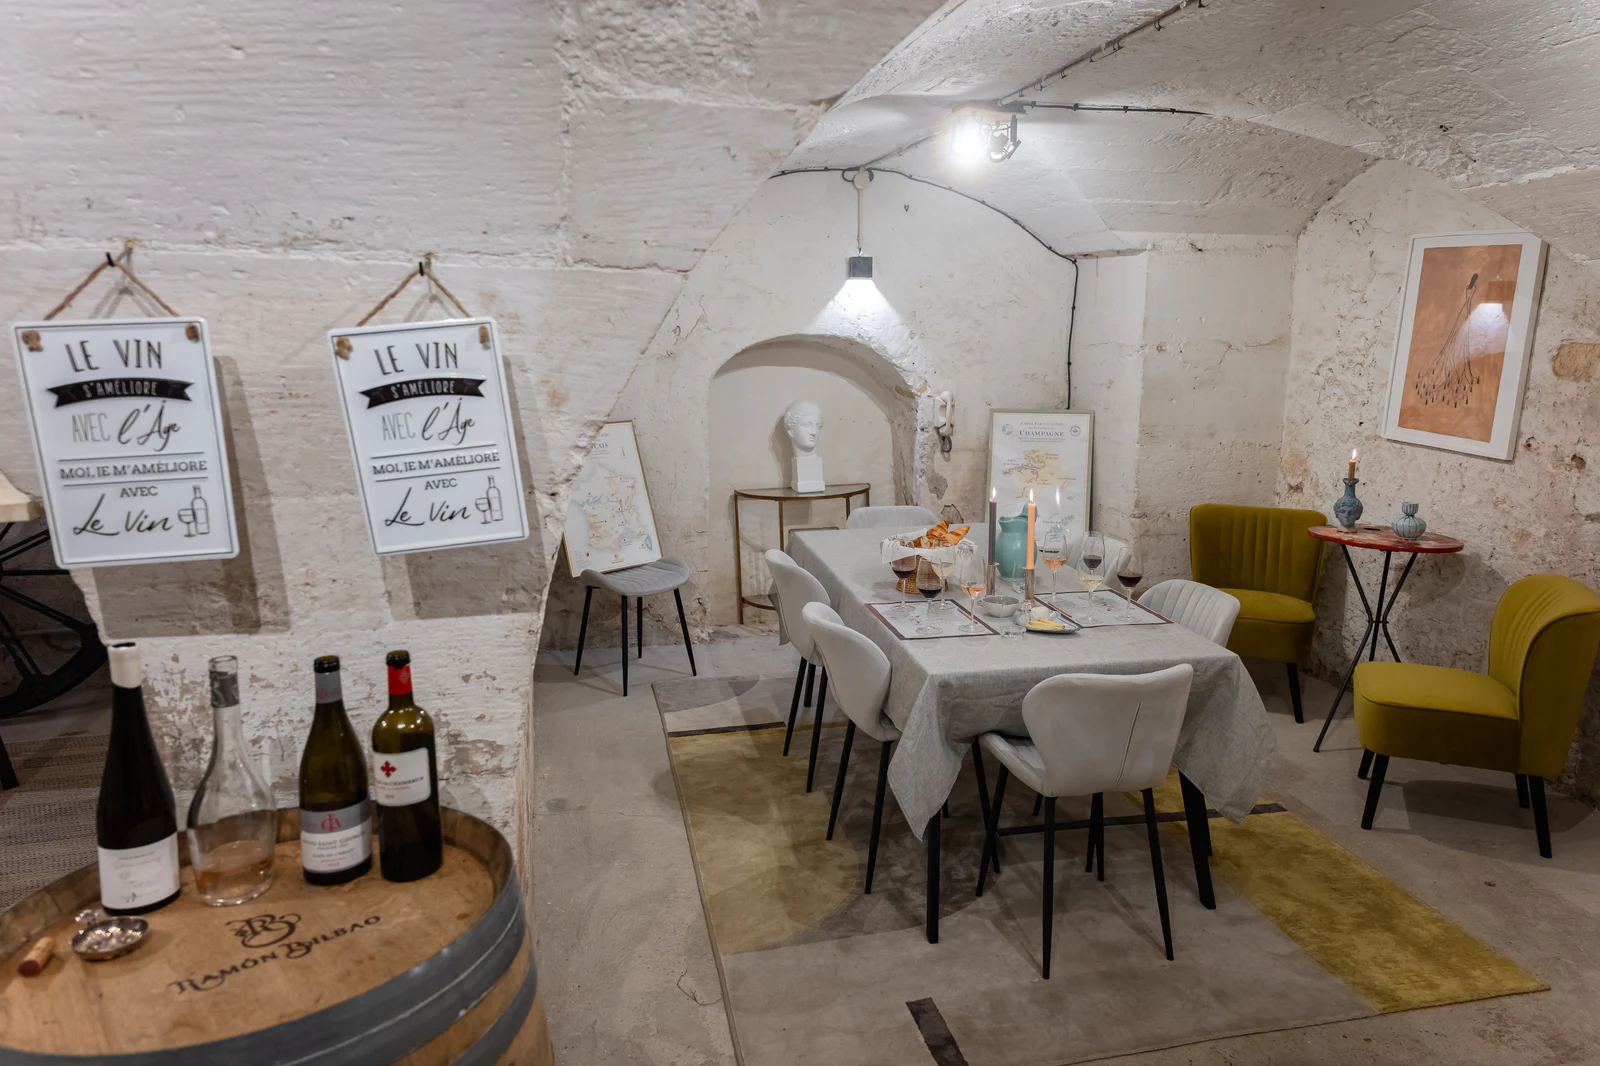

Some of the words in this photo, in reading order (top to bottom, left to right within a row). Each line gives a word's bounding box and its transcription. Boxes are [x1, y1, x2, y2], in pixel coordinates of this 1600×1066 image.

[65, 340, 100, 372] LE
[112, 339, 163, 369] VIN
[374, 345, 404, 376] LE
[416, 342, 458, 369] VIN
[83, 380, 158, 398] S'AMÉLIORE
[390, 380, 456, 399] S'AMÉLIORE
[71, 412, 111, 443] AVEC
[381, 412, 416, 441] AVEC
[119, 485, 158, 498] AVEC
[424, 478, 458, 491] AVEC
[72, 493, 120, 536] Le
[125, 509, 175, 533] Vin
[384, 487, 425, 527] Le
[429, 500, 471, 522] Vin
[167, 952, 278, 994] RAMÓN
[277, 915, 381, 959] BILBAO
